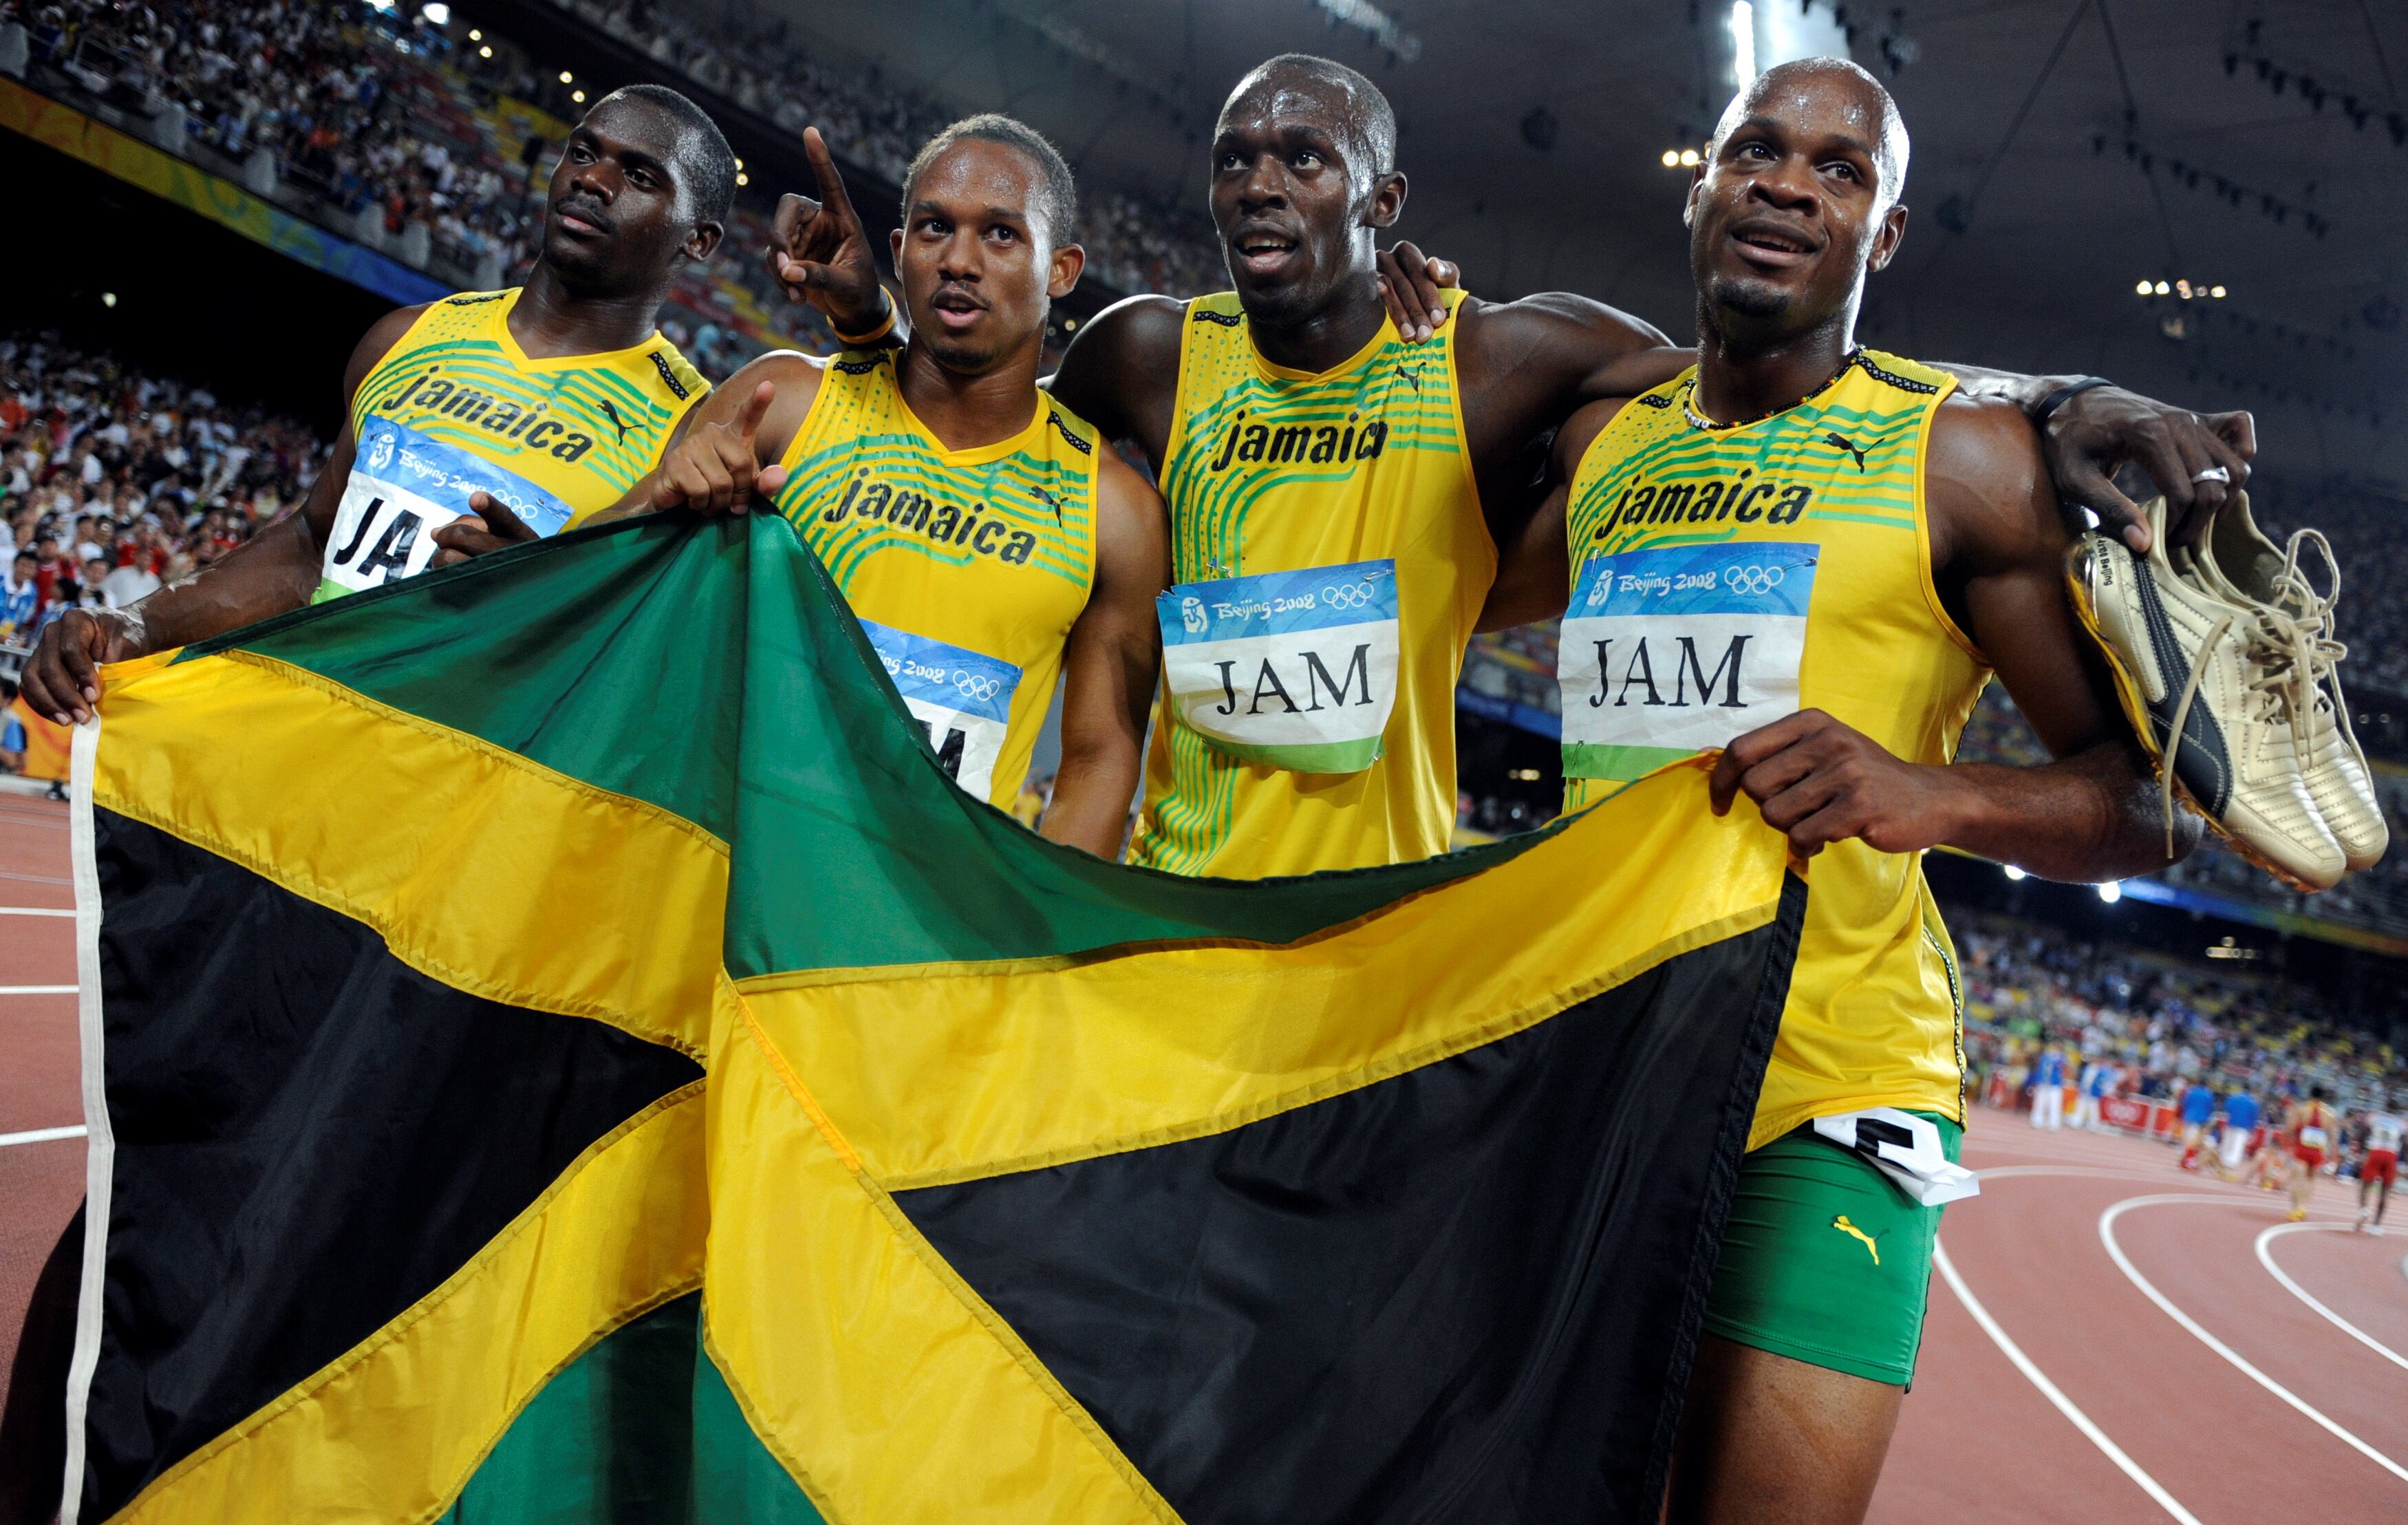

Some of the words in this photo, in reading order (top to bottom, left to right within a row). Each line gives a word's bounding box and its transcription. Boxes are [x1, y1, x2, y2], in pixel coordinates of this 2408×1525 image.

[383, 365, 593, 463] jamaica
[398, 449, 449, 487] Beijing
[1595, 468, 1813, 540] jamaica
[333, 497, 438, 584] JA
[824, 467, 1036, 566] jamaica
[1211, 599, 1271, 621] Beijing
[1273, 593, 1316, 612] 2008
[1617, 572, 1671, 597] Beijing
[1673, 571, 1717, 590] 2008
[2100, 558, 2113, 586] Beijing
[902, 660, 945, 684] 2008
[1214, 643, 1375, 715] JAM
[1589, 634, 1754, 708] JAM
